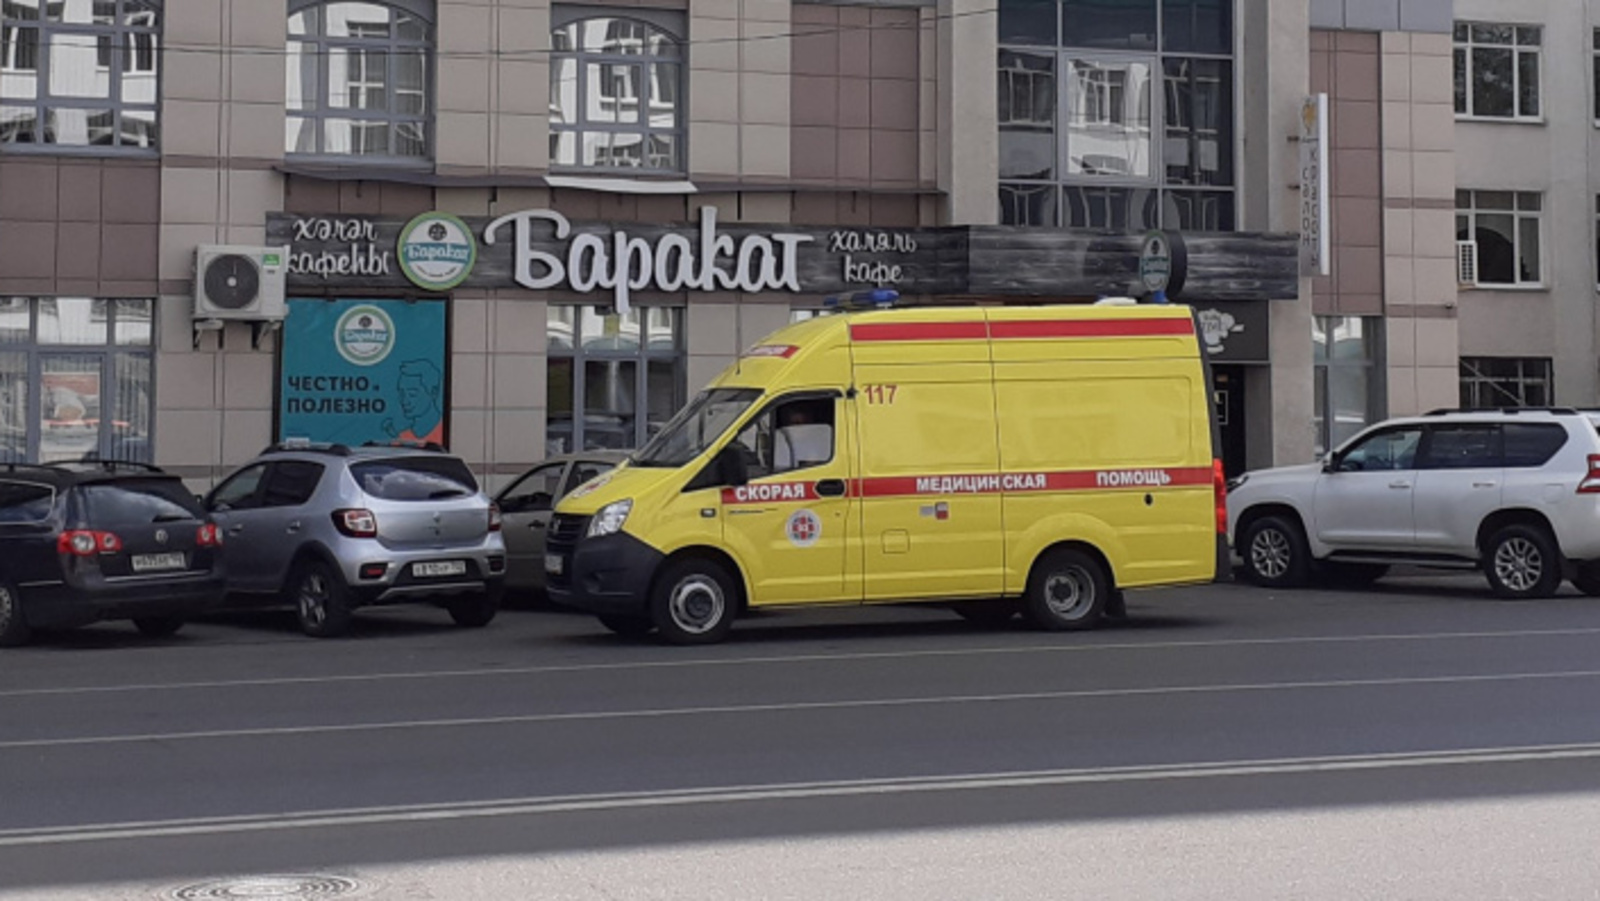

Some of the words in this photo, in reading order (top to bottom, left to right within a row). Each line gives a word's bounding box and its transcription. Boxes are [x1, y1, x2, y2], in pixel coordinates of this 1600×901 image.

[829, 230, 918, 253] халяль
[485, 205, 815, 314] Баракат
[844, 254, 904, 288] кафе
[287, 375, 370, 391] ЧЕСТНО
[865, 384, 897, 404] 117
[287, 398, 387, 414] ПОЛЕЗНО
[1096, 469, 1172, 487] ПОМОЩЬ
[735, 483, 805, 501] СКОРАЯ
